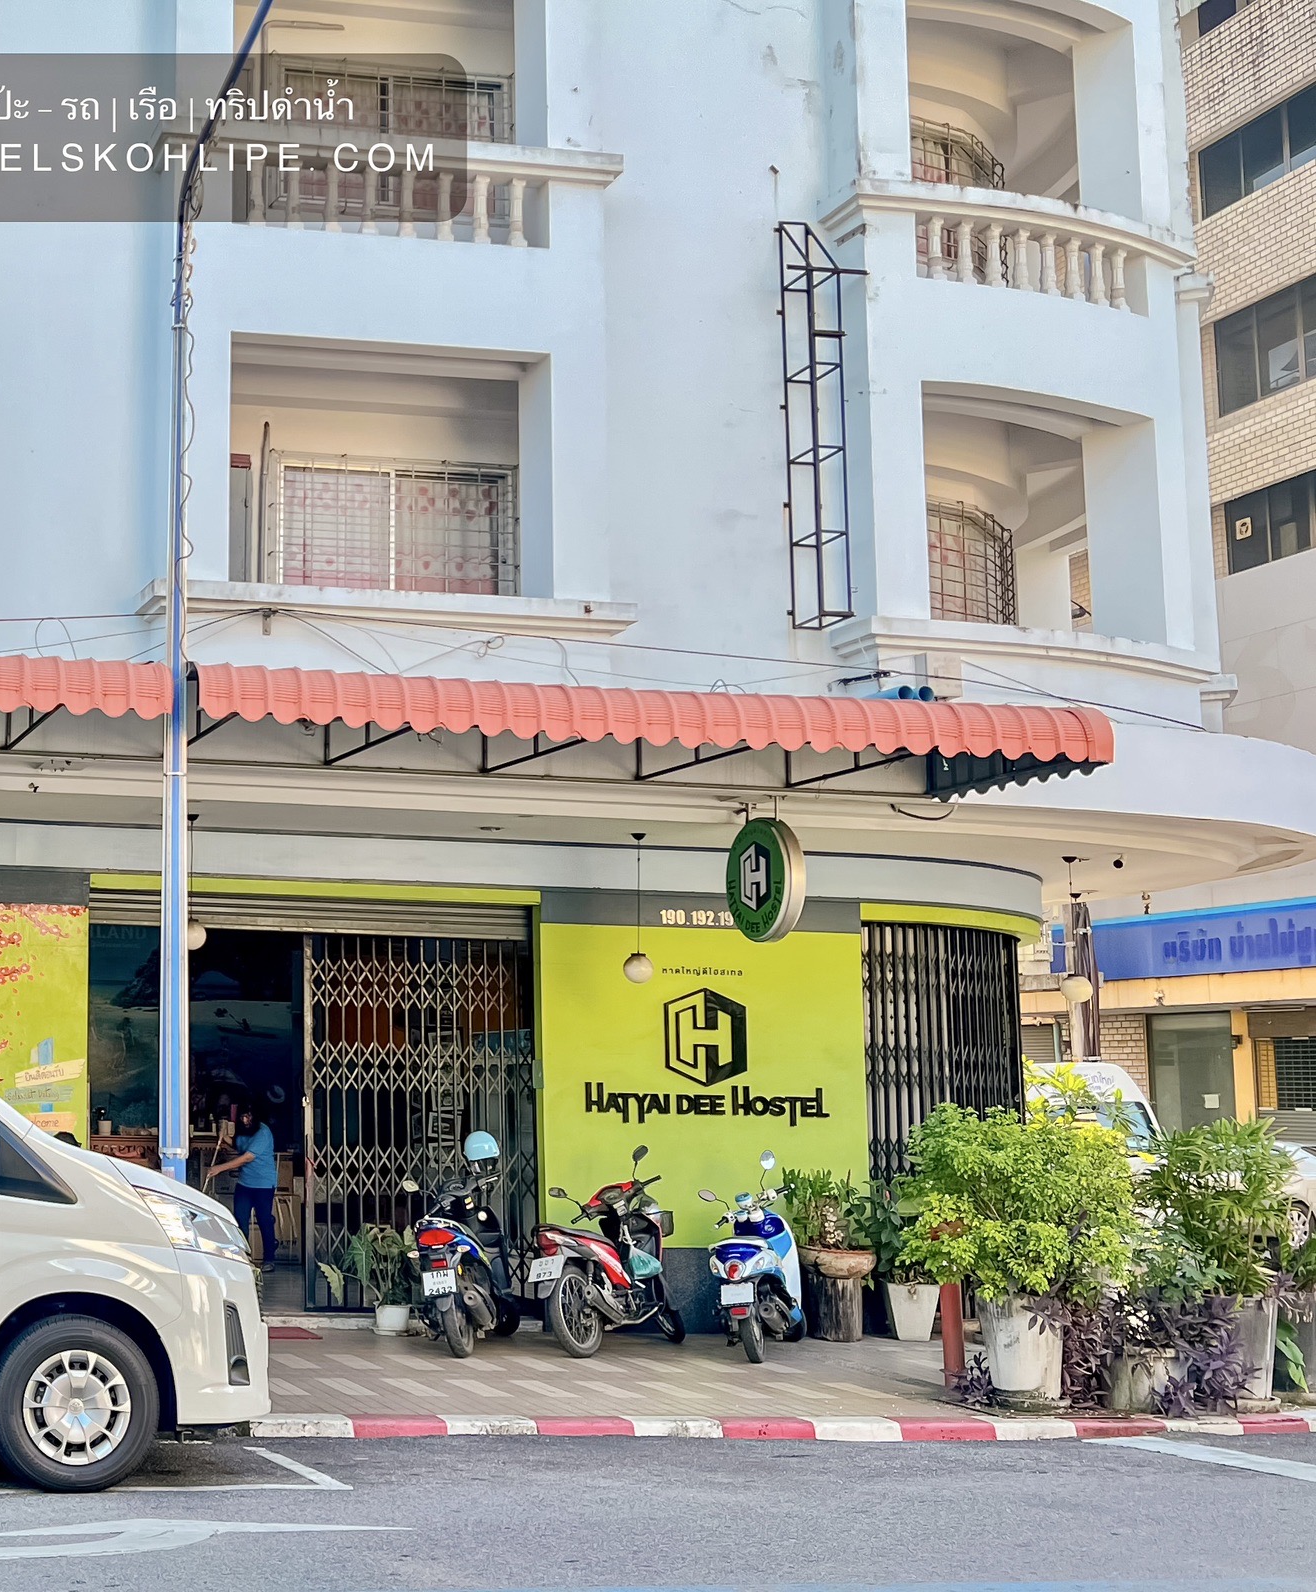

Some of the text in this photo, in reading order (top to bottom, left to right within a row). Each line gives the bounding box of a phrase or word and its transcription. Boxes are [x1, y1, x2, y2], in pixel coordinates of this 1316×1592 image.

[660, 909, 734, 926] 190.192.19
[745, 920, 760, 933] DEE
[676, 1094, 726, 1115] DEE
[731, 1085, 830, 1127] HOSTEL
[90, 1144, 155, 1154] ECEPTION
